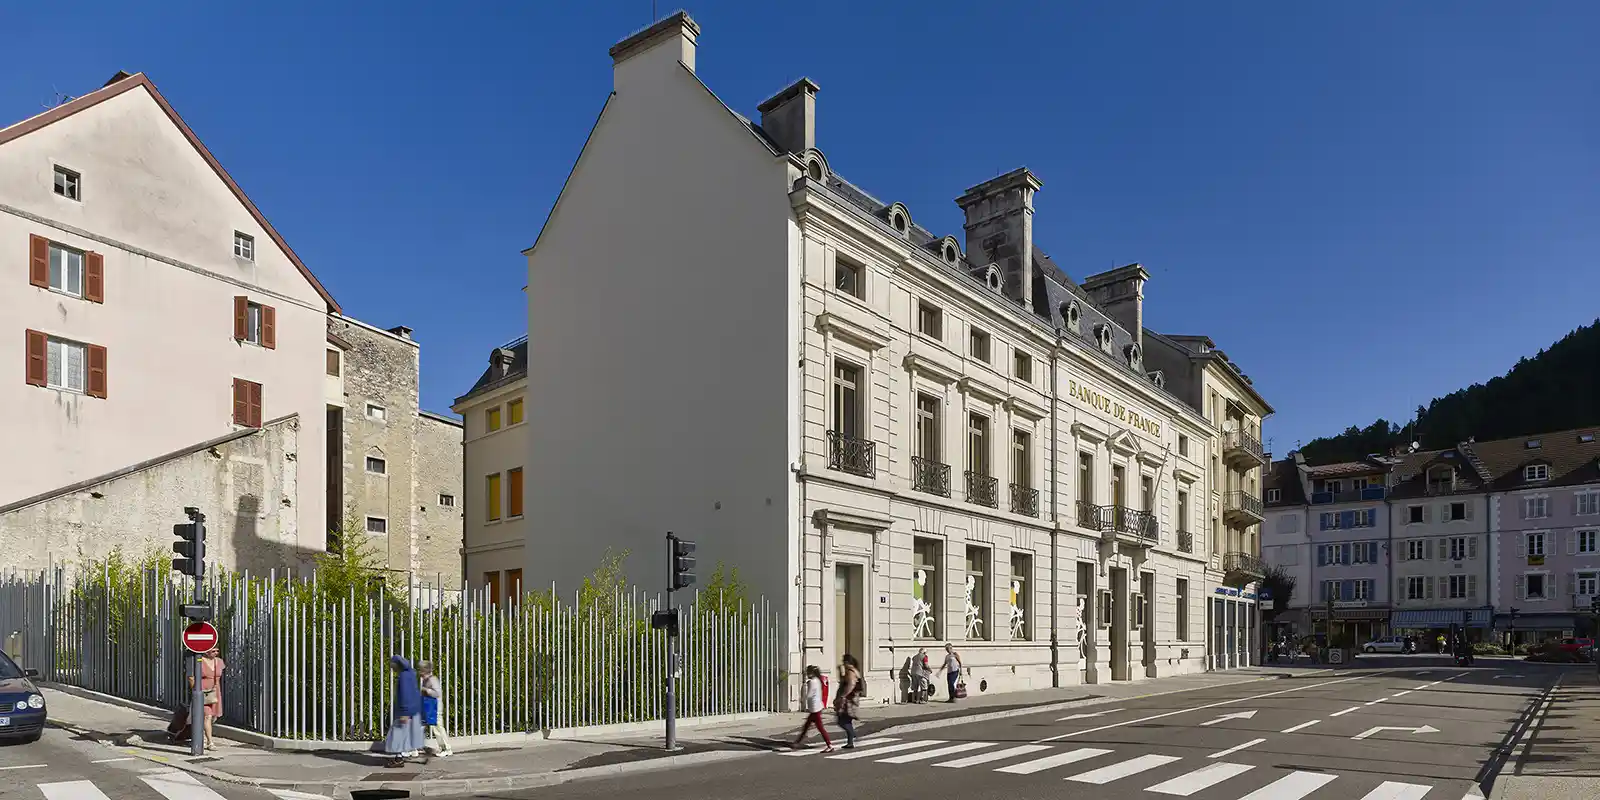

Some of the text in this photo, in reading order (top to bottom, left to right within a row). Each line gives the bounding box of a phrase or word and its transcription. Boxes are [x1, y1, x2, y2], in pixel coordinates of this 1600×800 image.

[1069, 379, 1161, 438] BANQUE DE FRANCE
